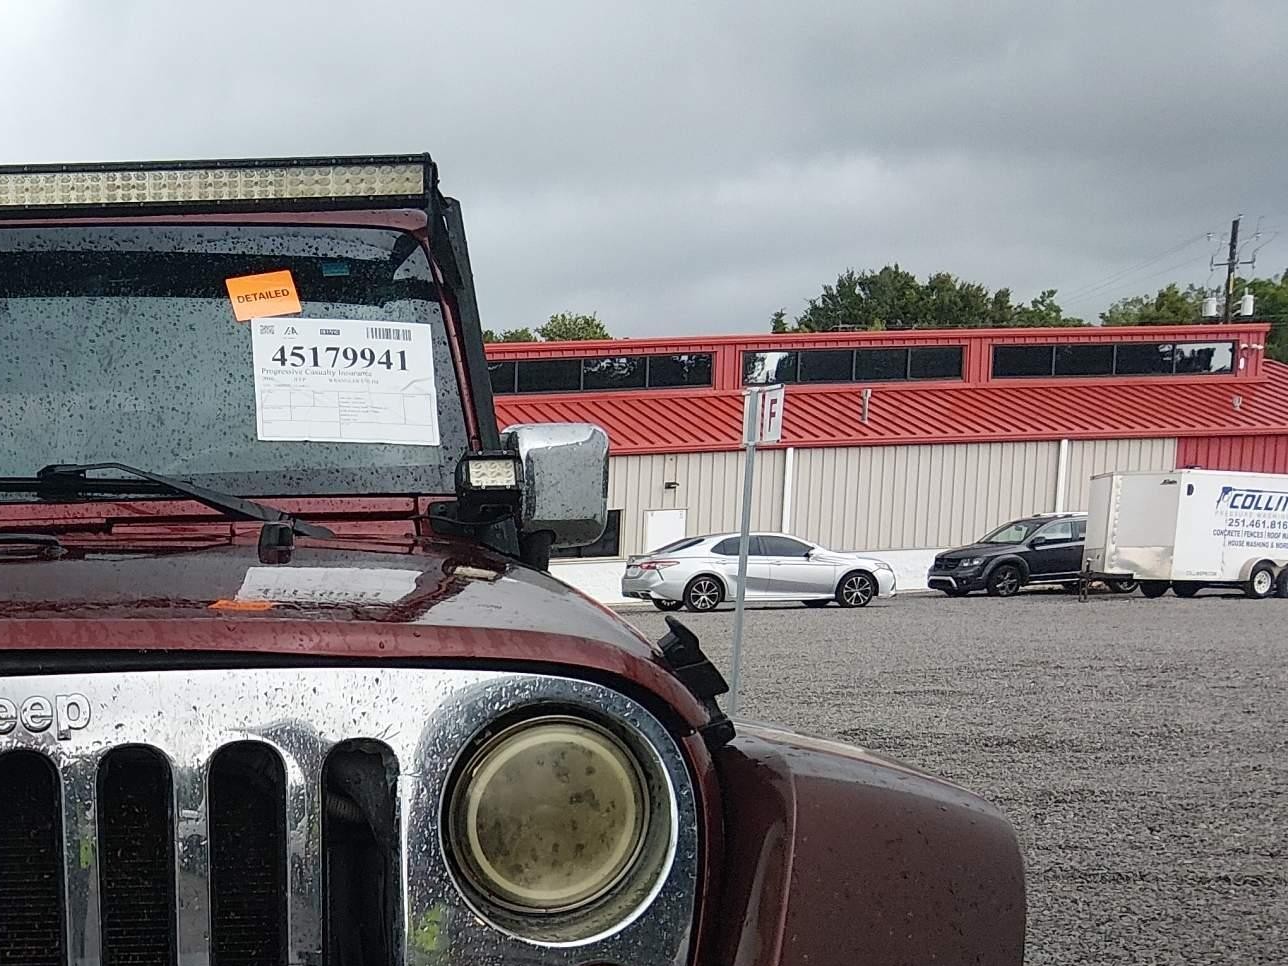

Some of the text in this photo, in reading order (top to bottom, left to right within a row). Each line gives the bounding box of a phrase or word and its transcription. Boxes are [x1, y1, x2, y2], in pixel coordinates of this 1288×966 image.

[237, 289, 290, 304] DETAILED
[272, 345, 409, 371] 45179941
[261, 367, 373, 378] Progressive Casualty Insurance
[768, 398, 778, 433] F
[1212, 528, 1241, 538] CONCRETE
[1243, 530, 1264, 539] FENCES
